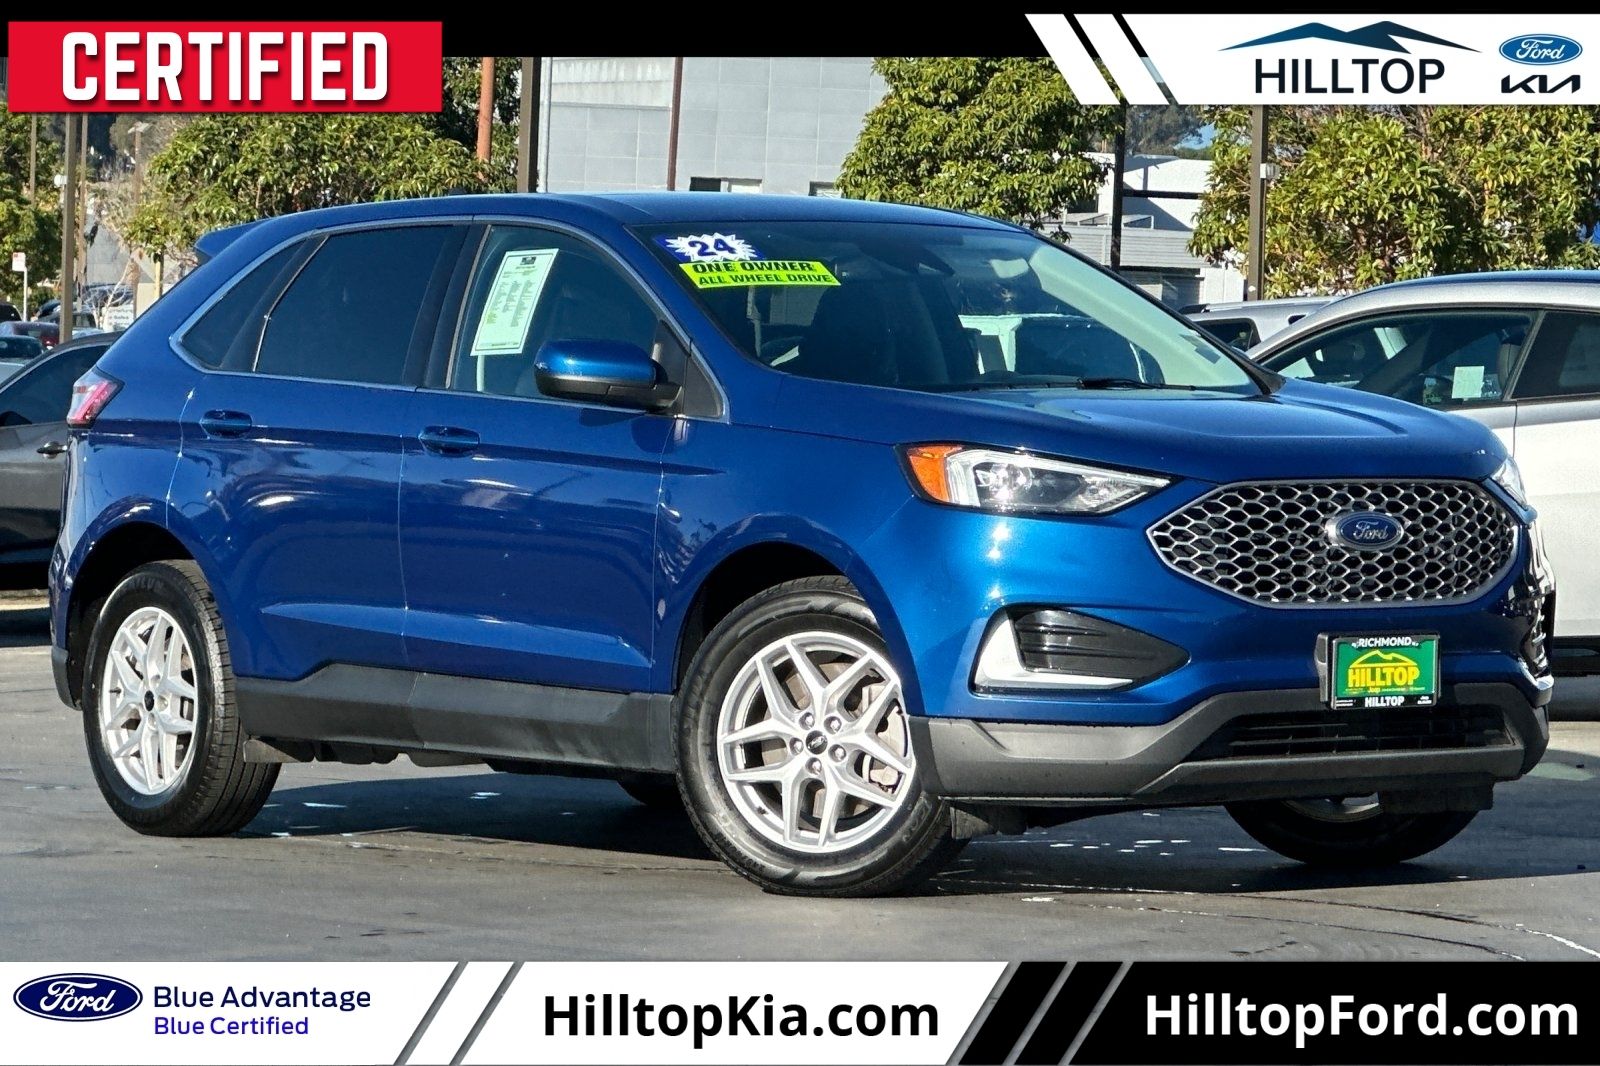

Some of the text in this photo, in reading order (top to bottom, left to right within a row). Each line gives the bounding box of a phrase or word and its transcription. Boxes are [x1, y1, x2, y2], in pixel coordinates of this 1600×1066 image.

[688, 238, 737, 257] 24
[692, 262, 814, 274] ONE OWNER
[698, 273, 833, 286] ALL WHEEL DRIVE
[1353, 520, 1389, 540] Ford
[1357, 637, 1412, 648] RICHMOND
[1347, 667, 1420, 687] HILLTOP
[1364, 696, 1405, 708] HILLTOP
